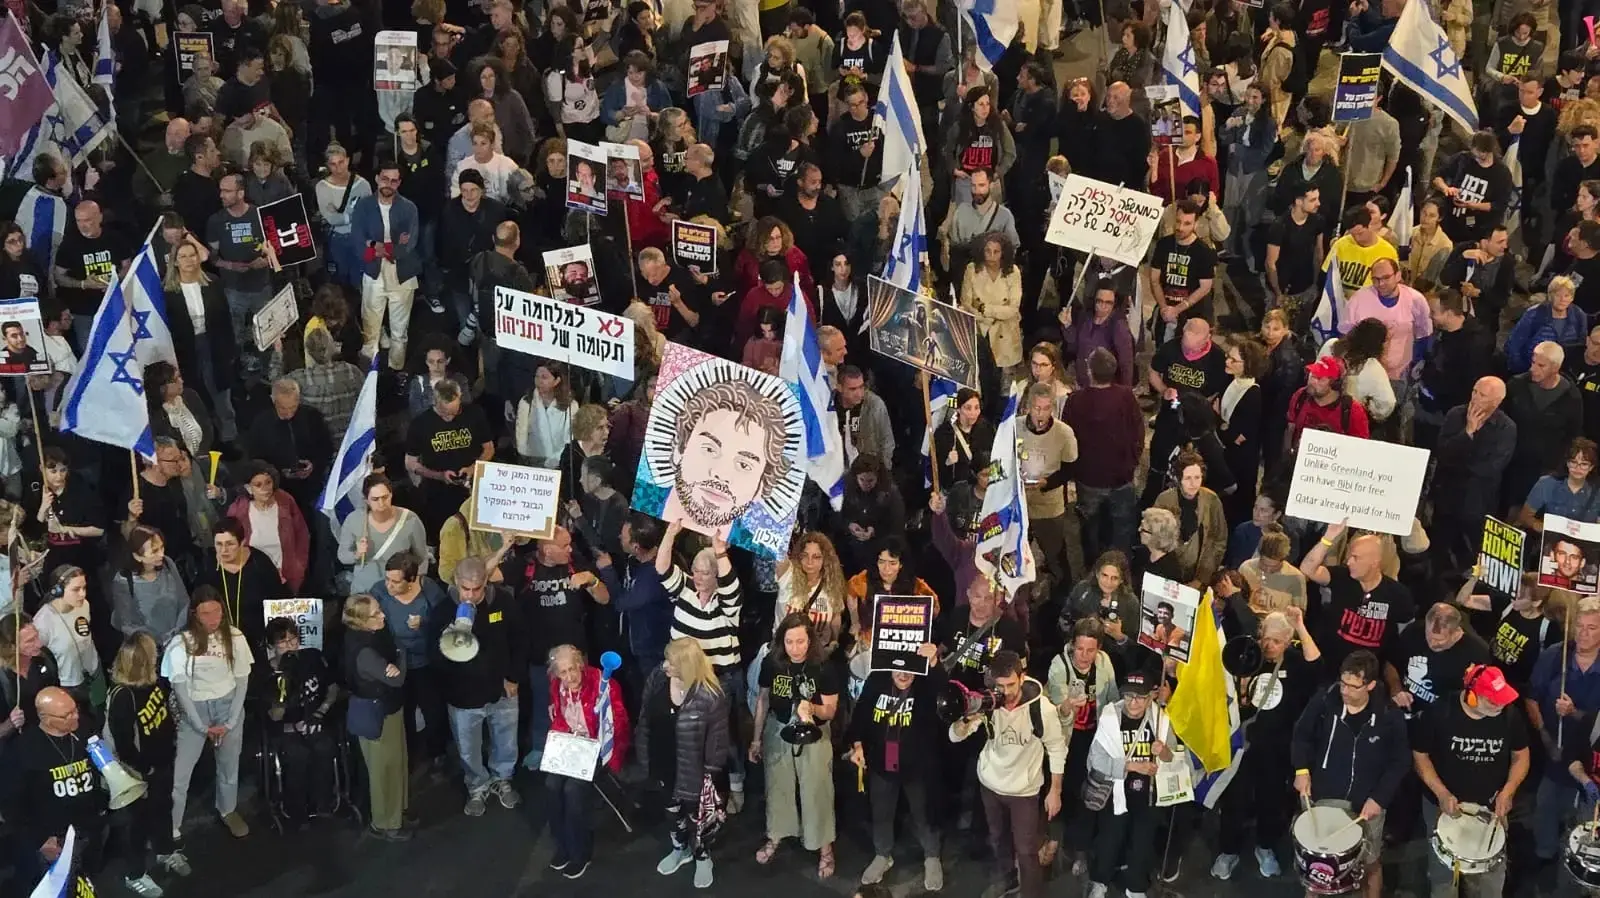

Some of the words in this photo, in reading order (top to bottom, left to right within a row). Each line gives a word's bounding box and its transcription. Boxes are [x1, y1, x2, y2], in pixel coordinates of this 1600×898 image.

[1067, 193, 1087, 211] רק
[1078, 186, 1114, 205] הזאת
[1083, 209, 1098, 231] של
[1110, 207, 1138, 226] מוסר
[1102, 222, 1121, 237] שם
[1339, 260, 1371, 287] NOW
[496, 288, 515, 312] על
[522, 298, 585, 328] למלחמה
[497, 310, 543, 342] נתניהו!
[597, 315, 625, 338] לא
[550, 324, 570, 348] של
[576, 333, 625, 362] תקומה
[431, 428, 472, 442] STAM
[431, 438, 472, 452] WARS
[1307, 442, 1338, 458] Donald,
[497, 468, 508, 477] של
[511, 470, 530, 480] המגן
[532, 473, 554, 483] אנחנו
[1303, 457, 1329, 471] Unlike
[1331, 462, 1375, 480] Greenland,
[1377, 474, 1393, 483] you
[489, 482, 507, 491] כנגד
[510, 485, 527, 496] הסף
[530, 487, 552, 497] שומרי
[1300, 474, 1314, 483] can
[1316, 477, 1335, 488] have
[1337, 479, 1353, 491] Bibi
[1355, 482, 1367, 493] for
[521, 500, 544, 510] הבוגד
[1295, 492, 1318, 505] Qatar
[1320, 497, 1350, 513] already
[1351, 504, 1370, 517] paid
[1371, 506, 1384, 517] for
[1385, 511, 1401, 521] him
[755, 529, 780, 548] אלון
[1485, 518, 1498, 534] ALL
[1502, 527, 1523, 547] THEM
[1482, 531, 1521, 568] HOME
[1480, 552, 1519, 598] NOW!
[881, 613, 925, 625] החטופים
[897, 605, 925, 614] מצילים
[297, 625, 318, 636] EM
[1341, 608, 1386, 641] עכשיו
[879, 628, 925, 642] מסרבים
[1498, 621, 1514, 640] GET
[1514, 631, 1530, 649] MY
[53, 771, 94, 798] 06:2
